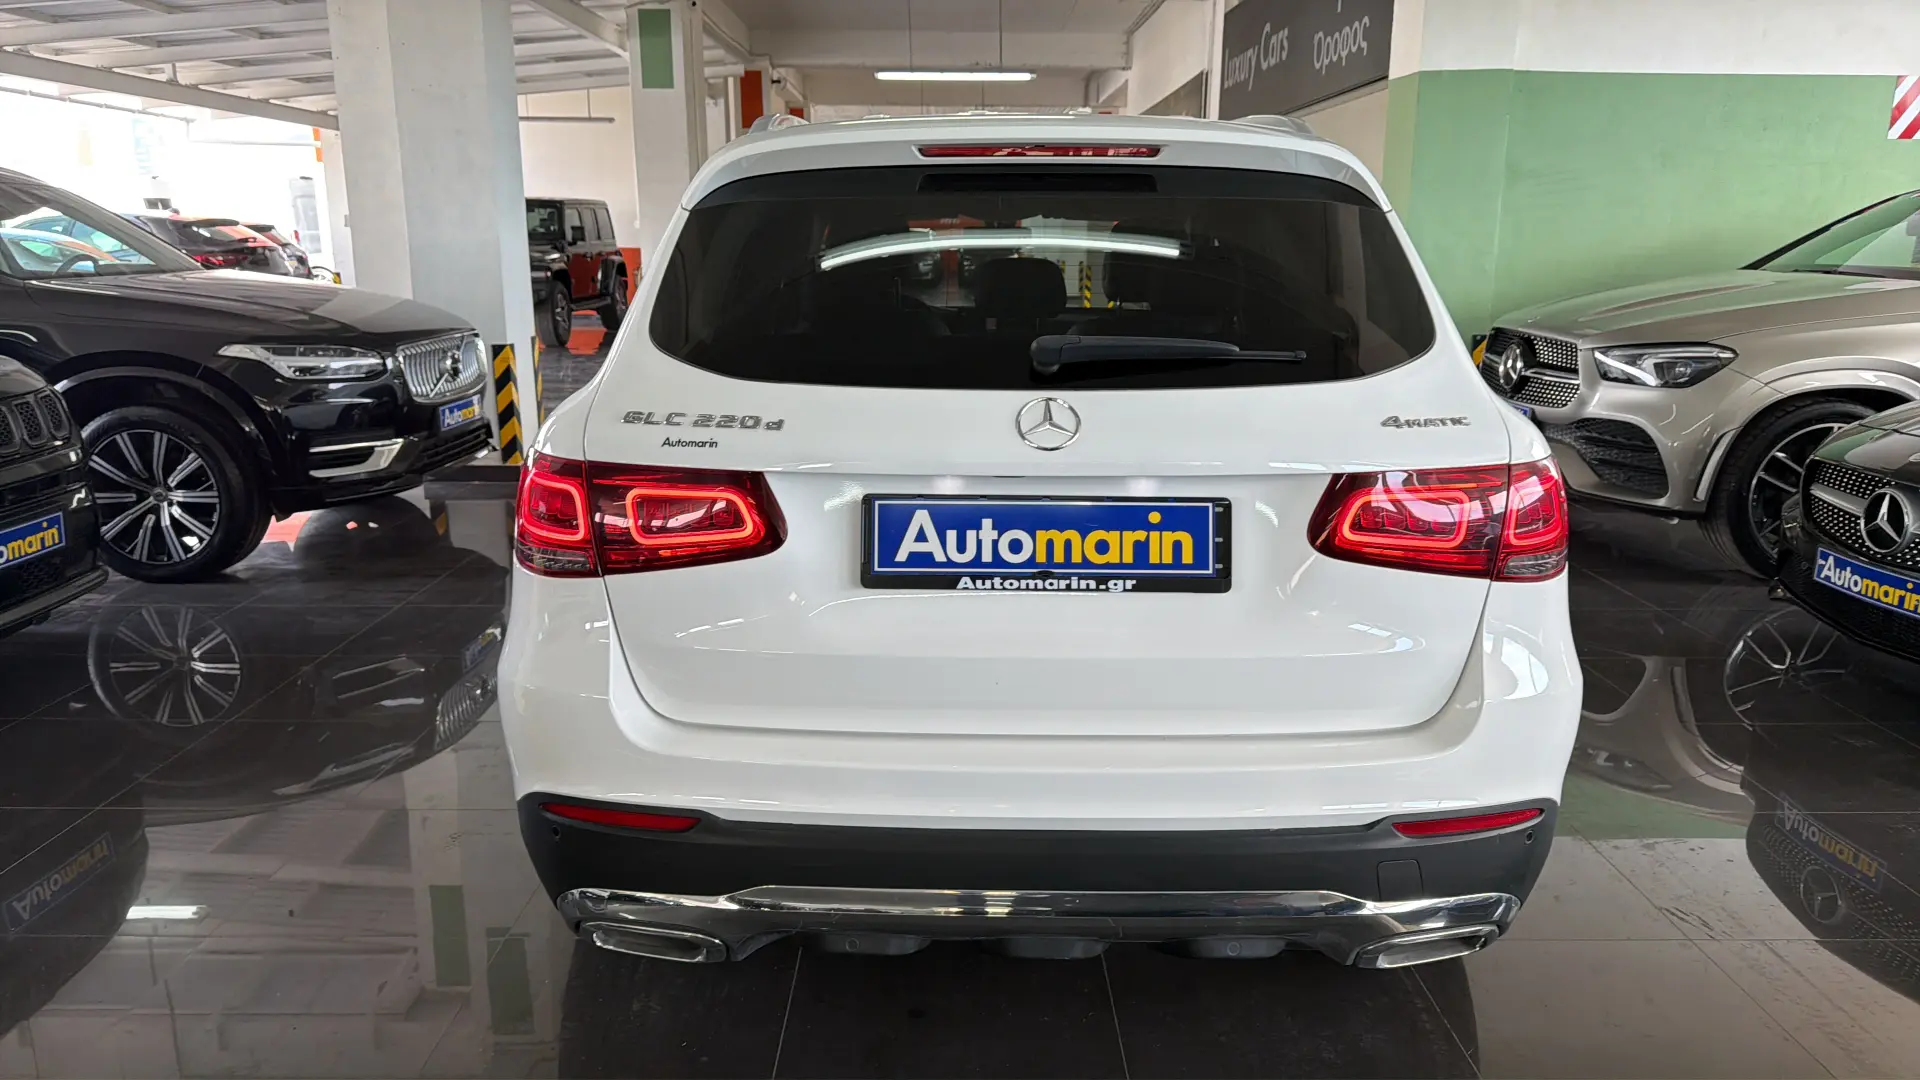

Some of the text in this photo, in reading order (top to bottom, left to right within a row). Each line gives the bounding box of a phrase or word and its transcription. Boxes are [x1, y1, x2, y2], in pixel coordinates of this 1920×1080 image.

[1224, 22, 1289, 91] Luxury Cars
[621, 411, 687, 426] GLC
[661, 436, 718, 449] Automarin
[894, 509, 1193, 564] Automarin
[956, 576, 1137, 592] Automarin.gr
